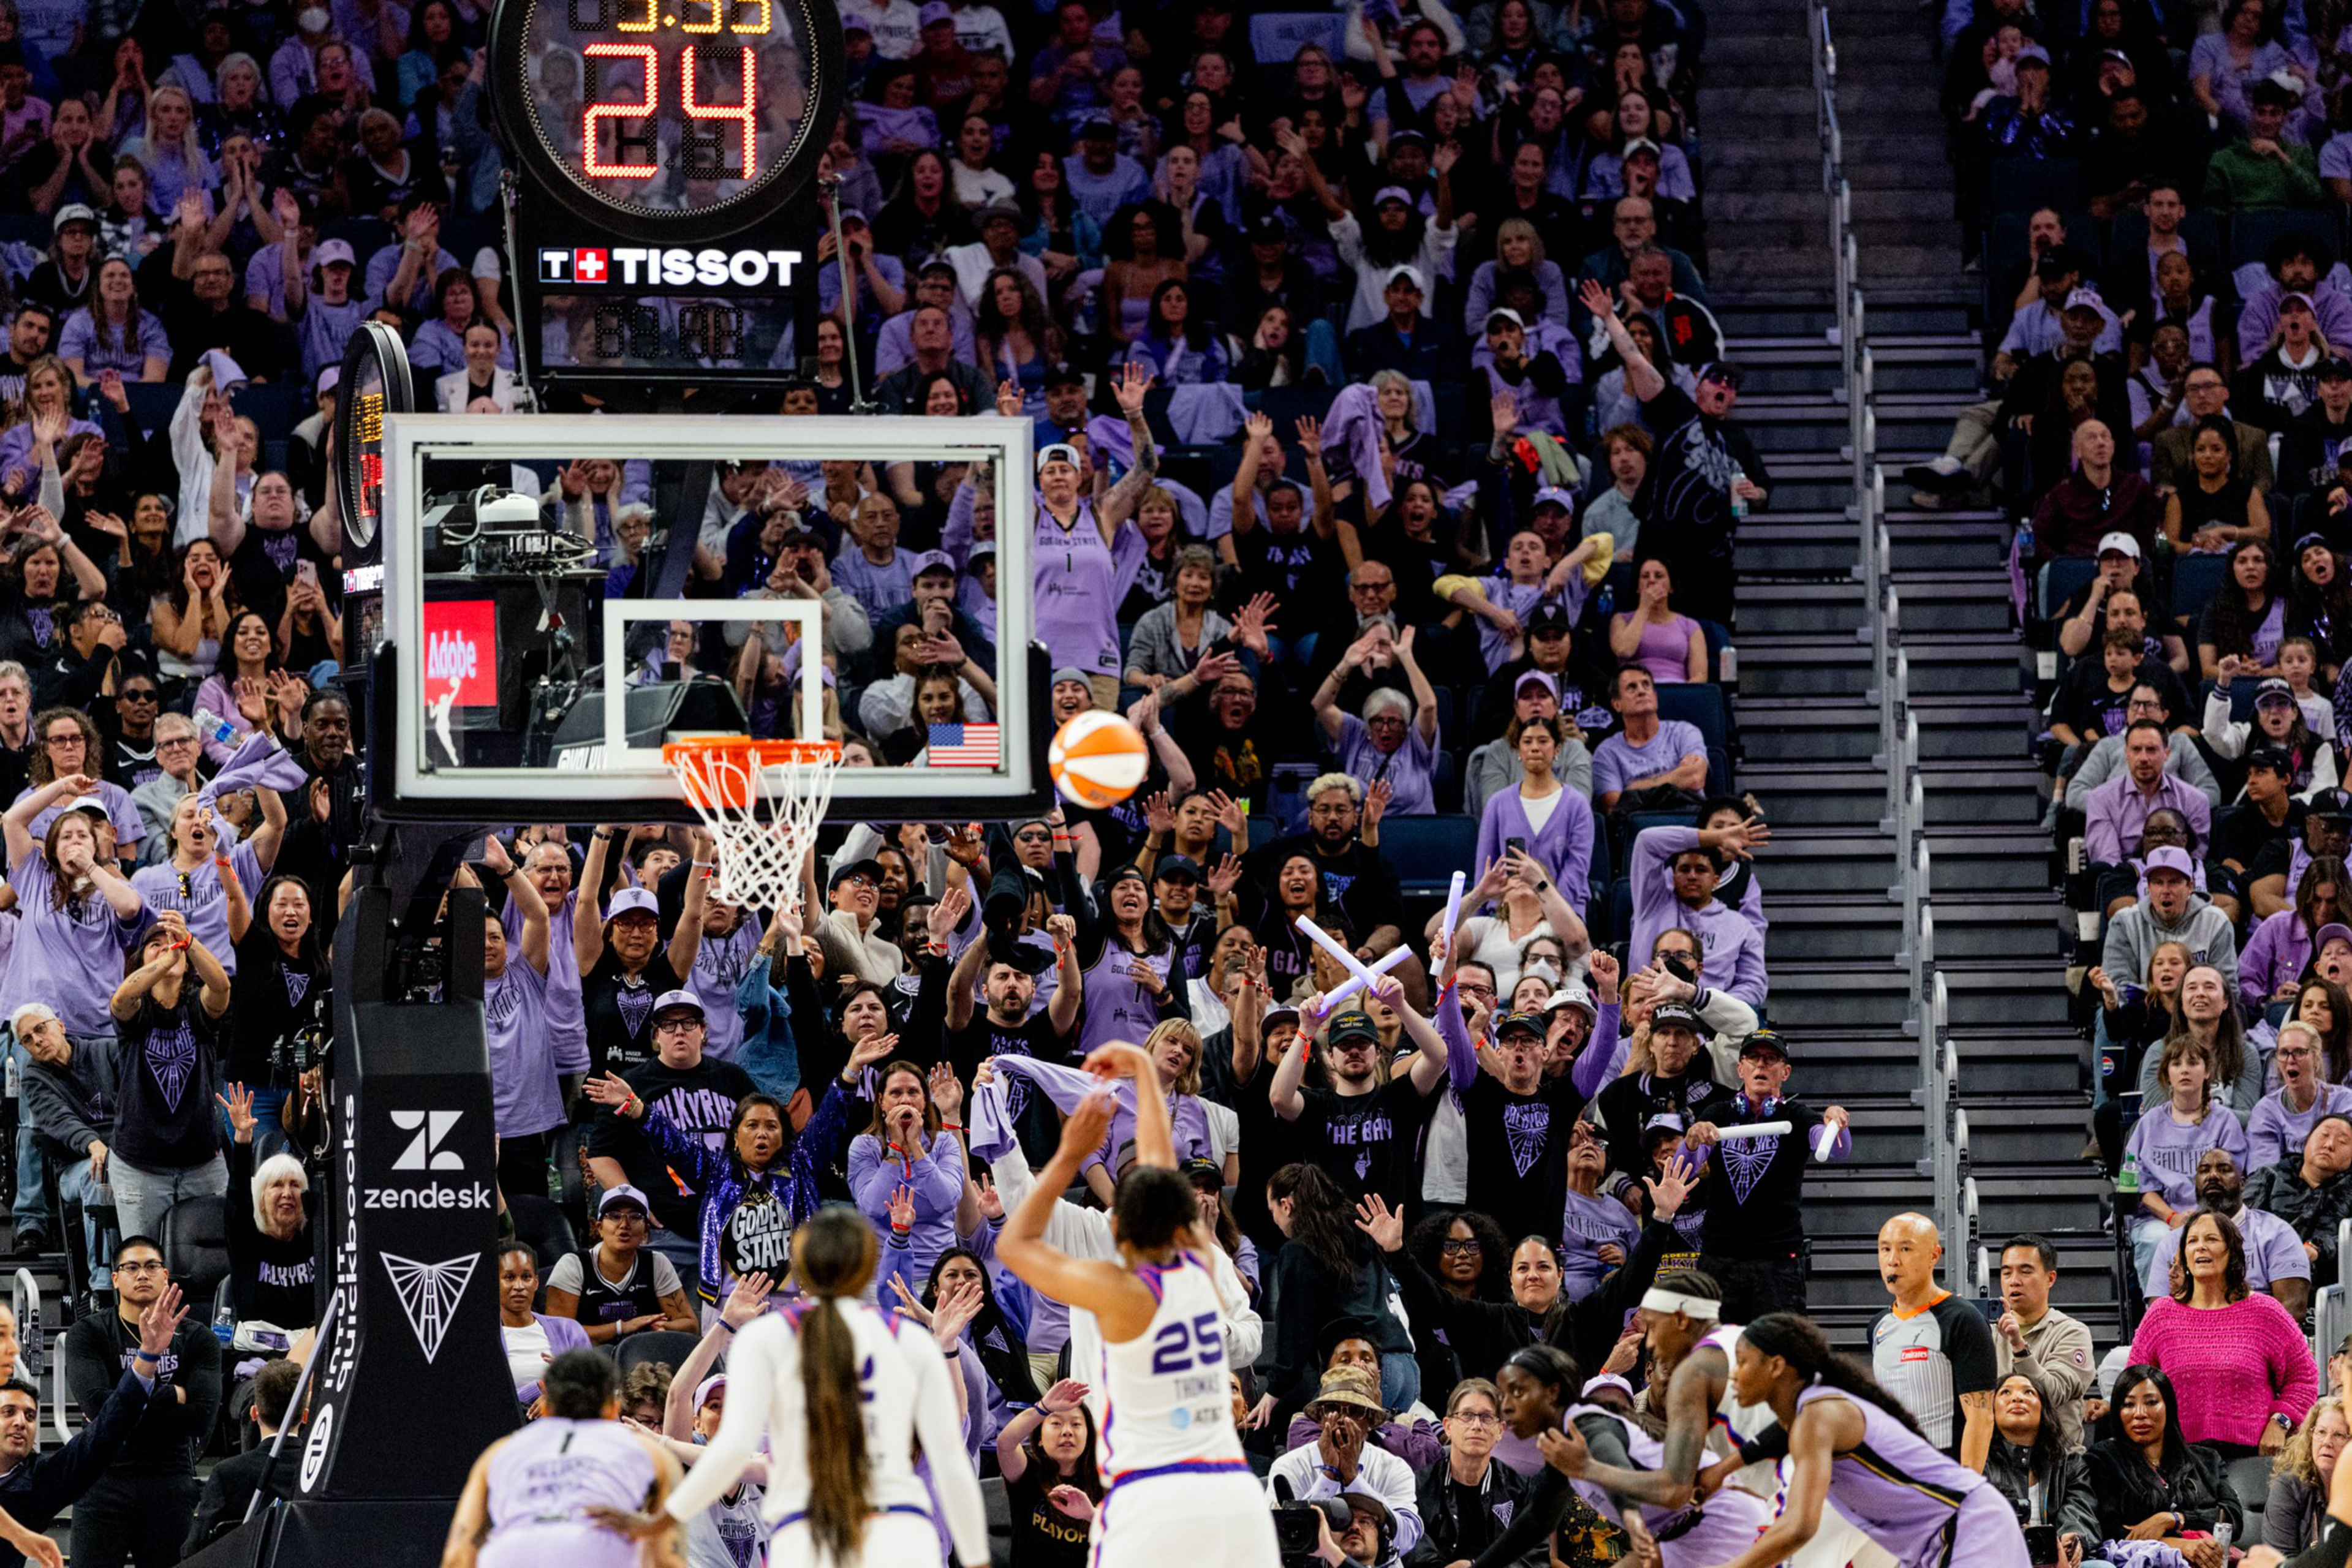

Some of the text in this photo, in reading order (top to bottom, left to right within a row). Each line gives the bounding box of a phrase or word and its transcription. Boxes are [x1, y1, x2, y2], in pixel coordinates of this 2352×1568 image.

[584, 43, 755, 179] 24
[613, 249, 802, 286] TISSOT
[1065, 552, 1071, 573] 1
[427, 630, 477, 679] Adobe
[1361, 1118, 1392, 1142] BAY
[364, 1182, 491, 1209] zendesk
[731, 1199, 791, 1242] GOLDEN
[337, 1094, 357, 1392] quickbooks
[1152, 1312, 1223, 1374] 25
[1902, 1349, 1928, 1360] Emirates
[559, 1431, 574, 1453] 1
[717, 1523, 757, 1539] VALKYRIES
